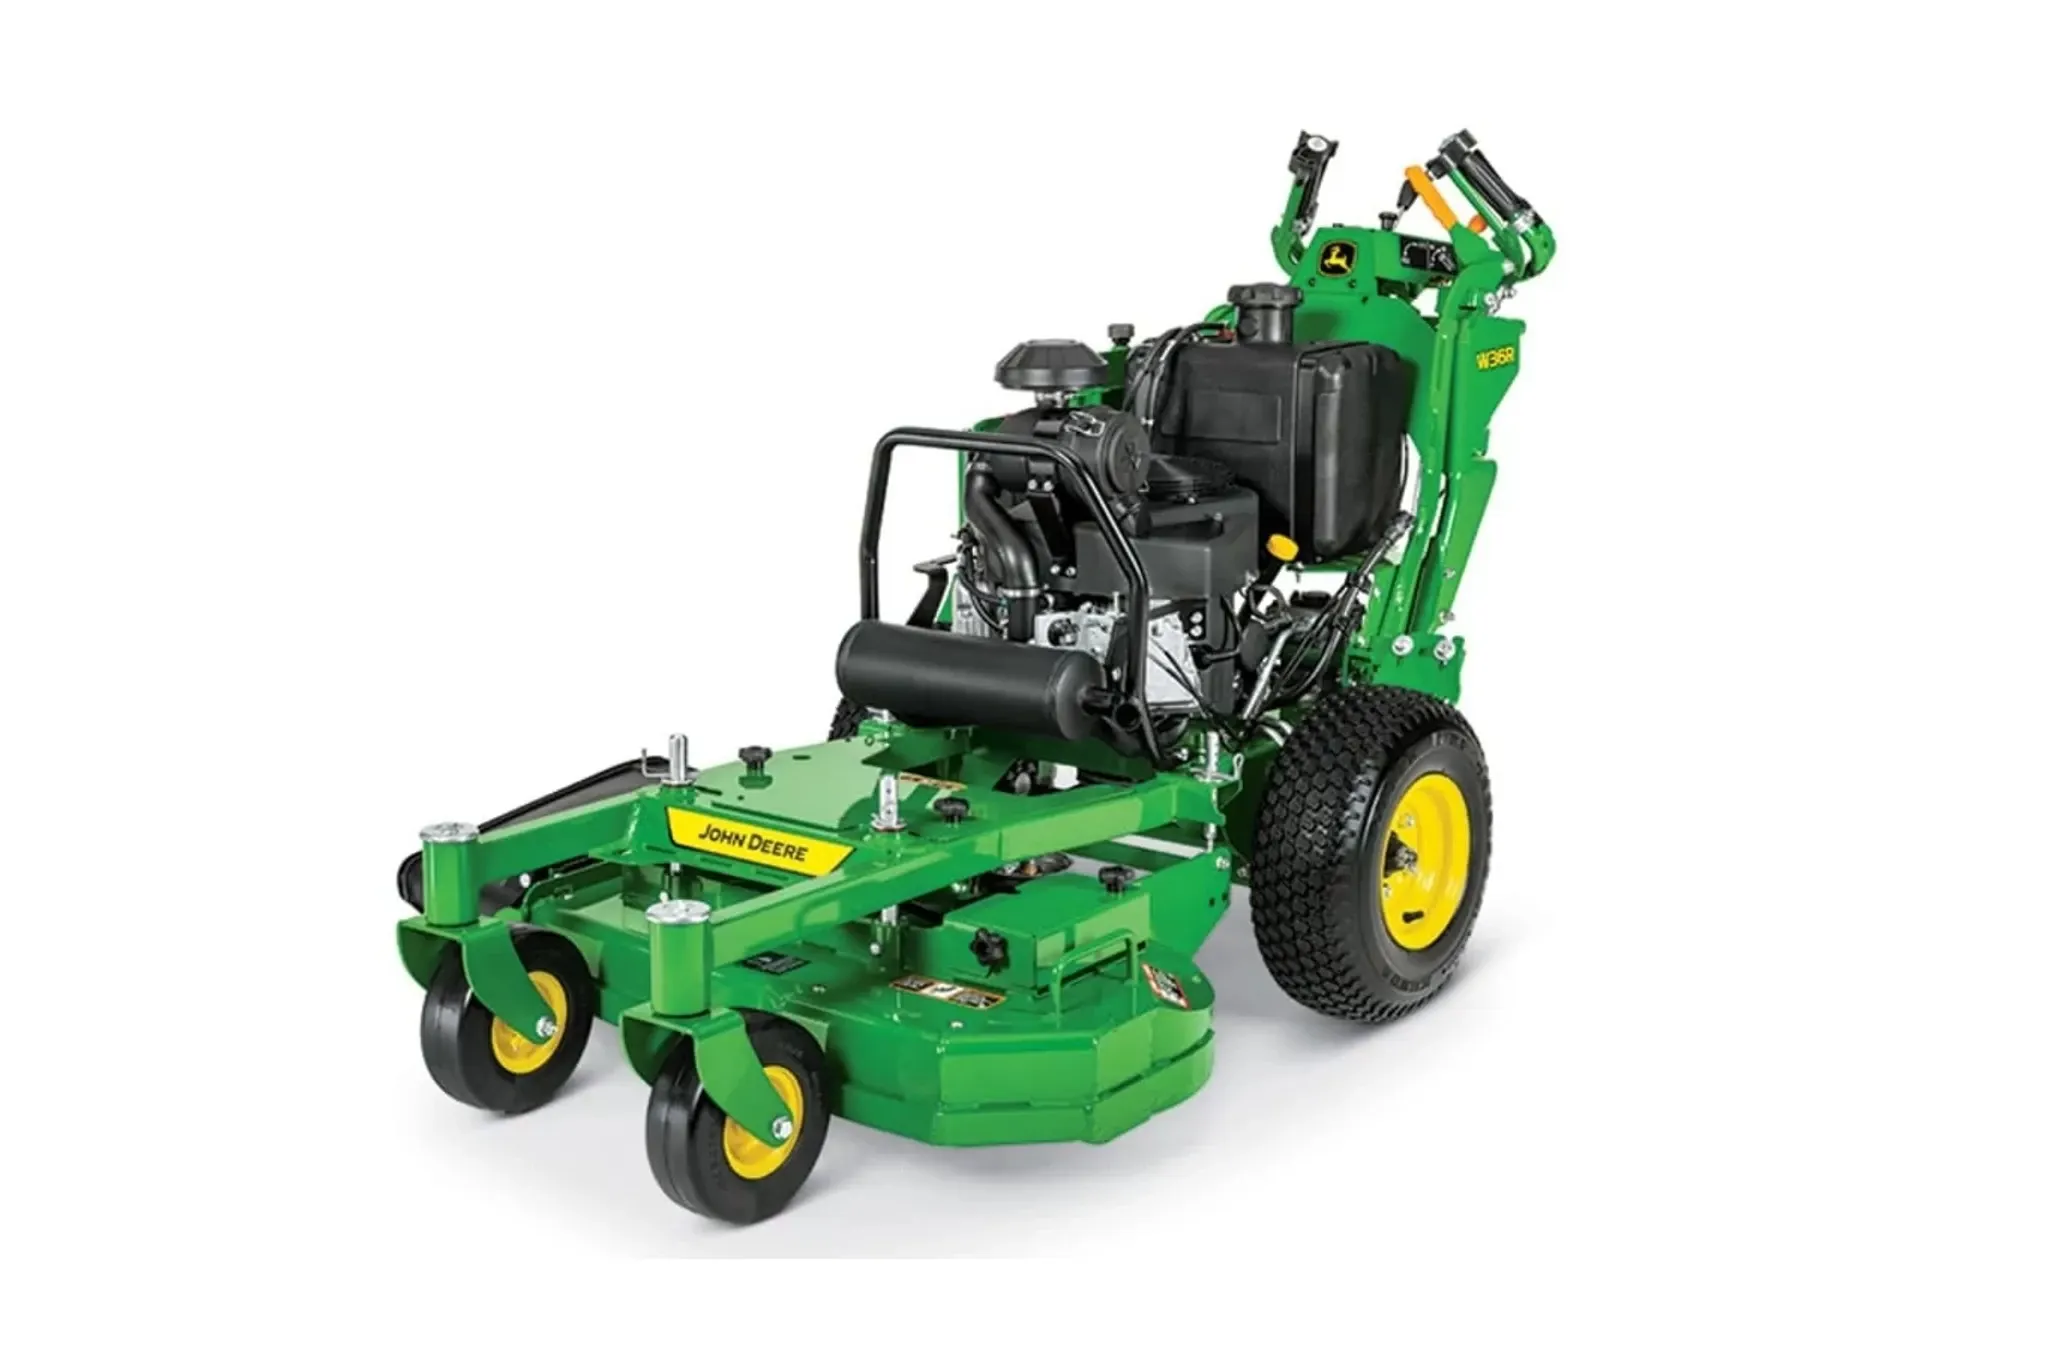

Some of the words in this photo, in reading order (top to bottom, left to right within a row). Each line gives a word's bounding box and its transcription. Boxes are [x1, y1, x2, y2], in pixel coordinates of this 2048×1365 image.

[1476, 347, 1514, 368] W36R
[699, 824, 746, 847] JOHN
[748, 833, 809, 862] DEERE
